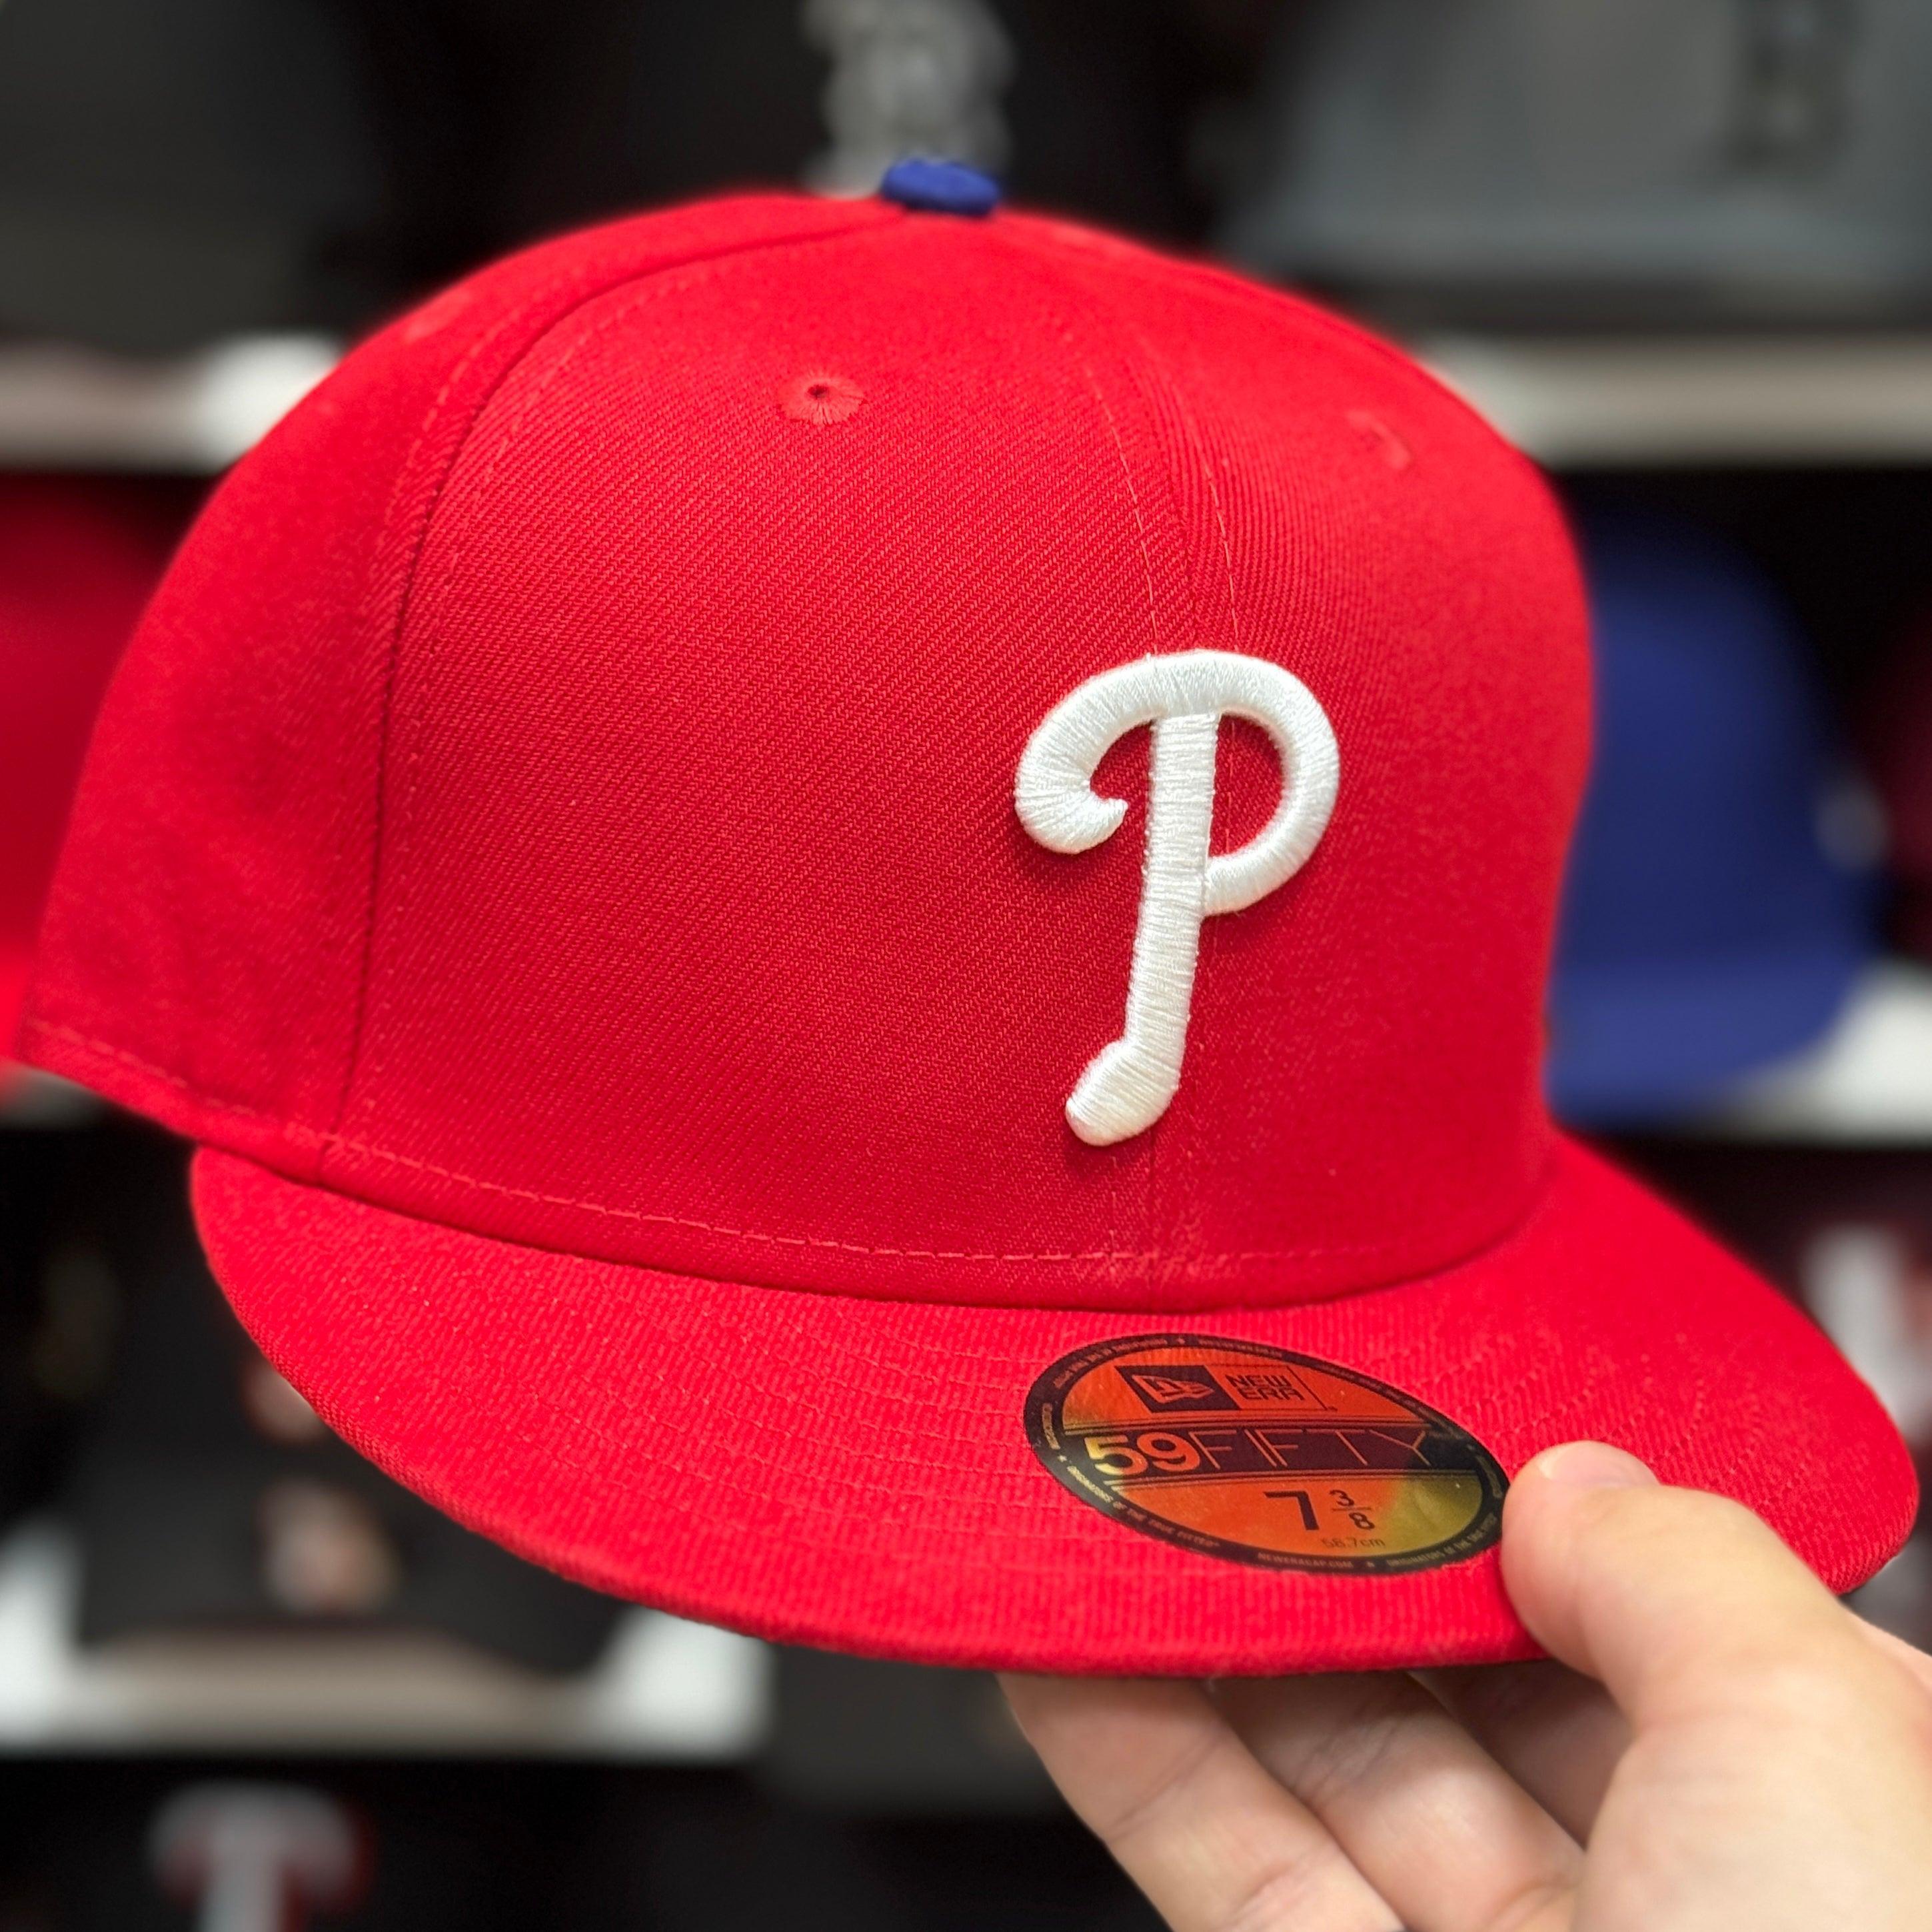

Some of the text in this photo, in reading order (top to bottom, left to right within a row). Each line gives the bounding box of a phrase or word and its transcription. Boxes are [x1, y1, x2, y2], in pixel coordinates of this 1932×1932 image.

[1014, 648, 1340, 1146] P
[1225, 1374, 1292, 1387] NEW
[1238, 1387, 1306, 1400] ERA
[1084, 1429, 1433, 1476] 59FIFTY
[1263, 1490, 1320, 1531] 7
